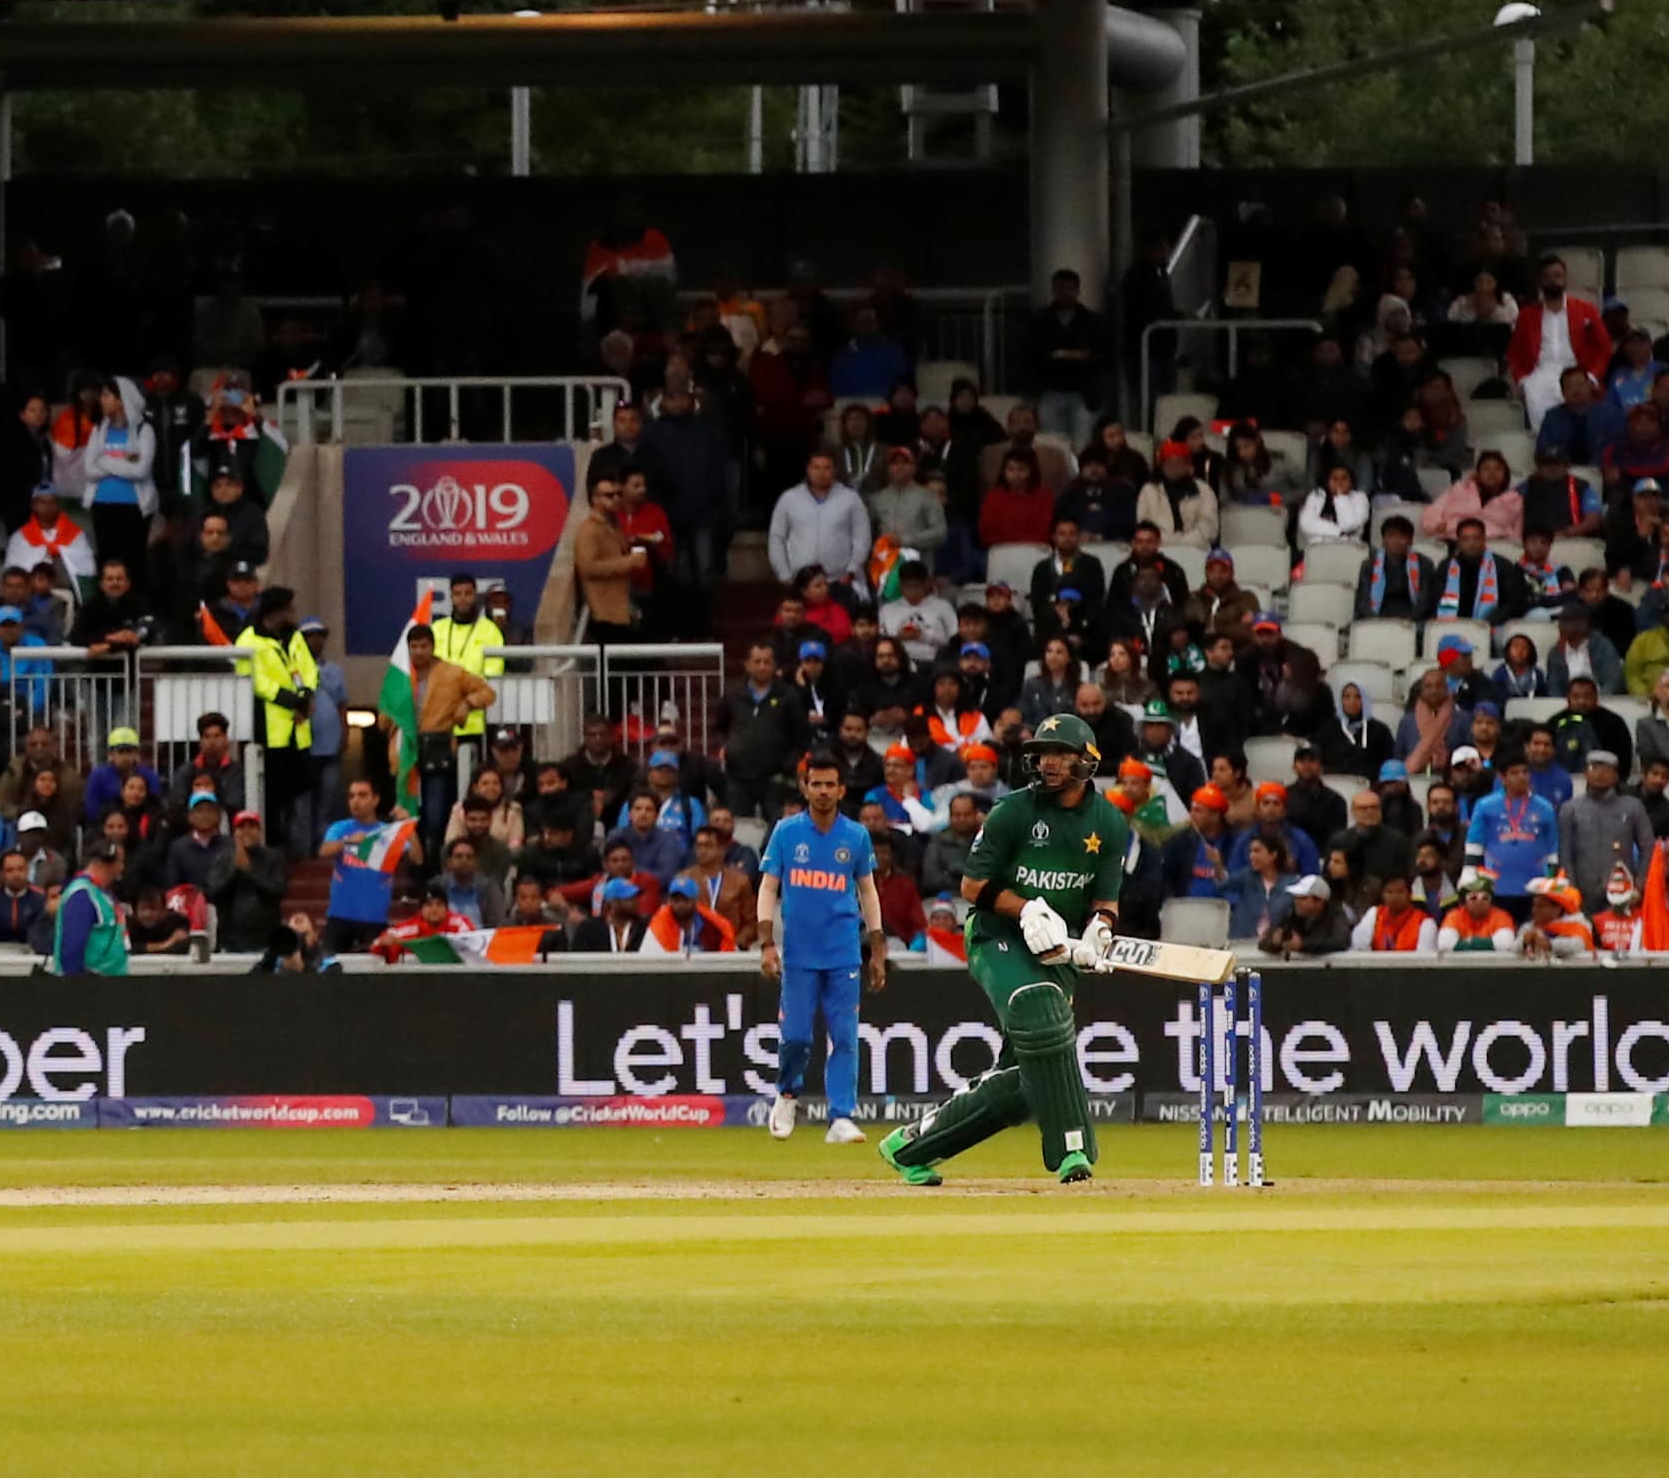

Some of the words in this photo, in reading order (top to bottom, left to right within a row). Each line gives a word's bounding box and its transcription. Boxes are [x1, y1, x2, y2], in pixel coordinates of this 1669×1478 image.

[389, 531, 462, 546] ENGLAND
[478, 531, 529, 545] WALES
[789, 868, 847, 892] INDIA
[826, 1020, 1141, 1094] moe
[1163, 996, 1351, 1094] the
[134, 1103, 360, 1123] www.cricketworldcup.com
[496, 1104, 552, 1122] Follow
[555, 1104, 710, 1124] @CricketWorldCup
[1367, 1099, 1467, 1123] MOBILITY
[1500, 1101, 1550, 1117] oppo
[1584, 1101, 1634, 1117] oppo
